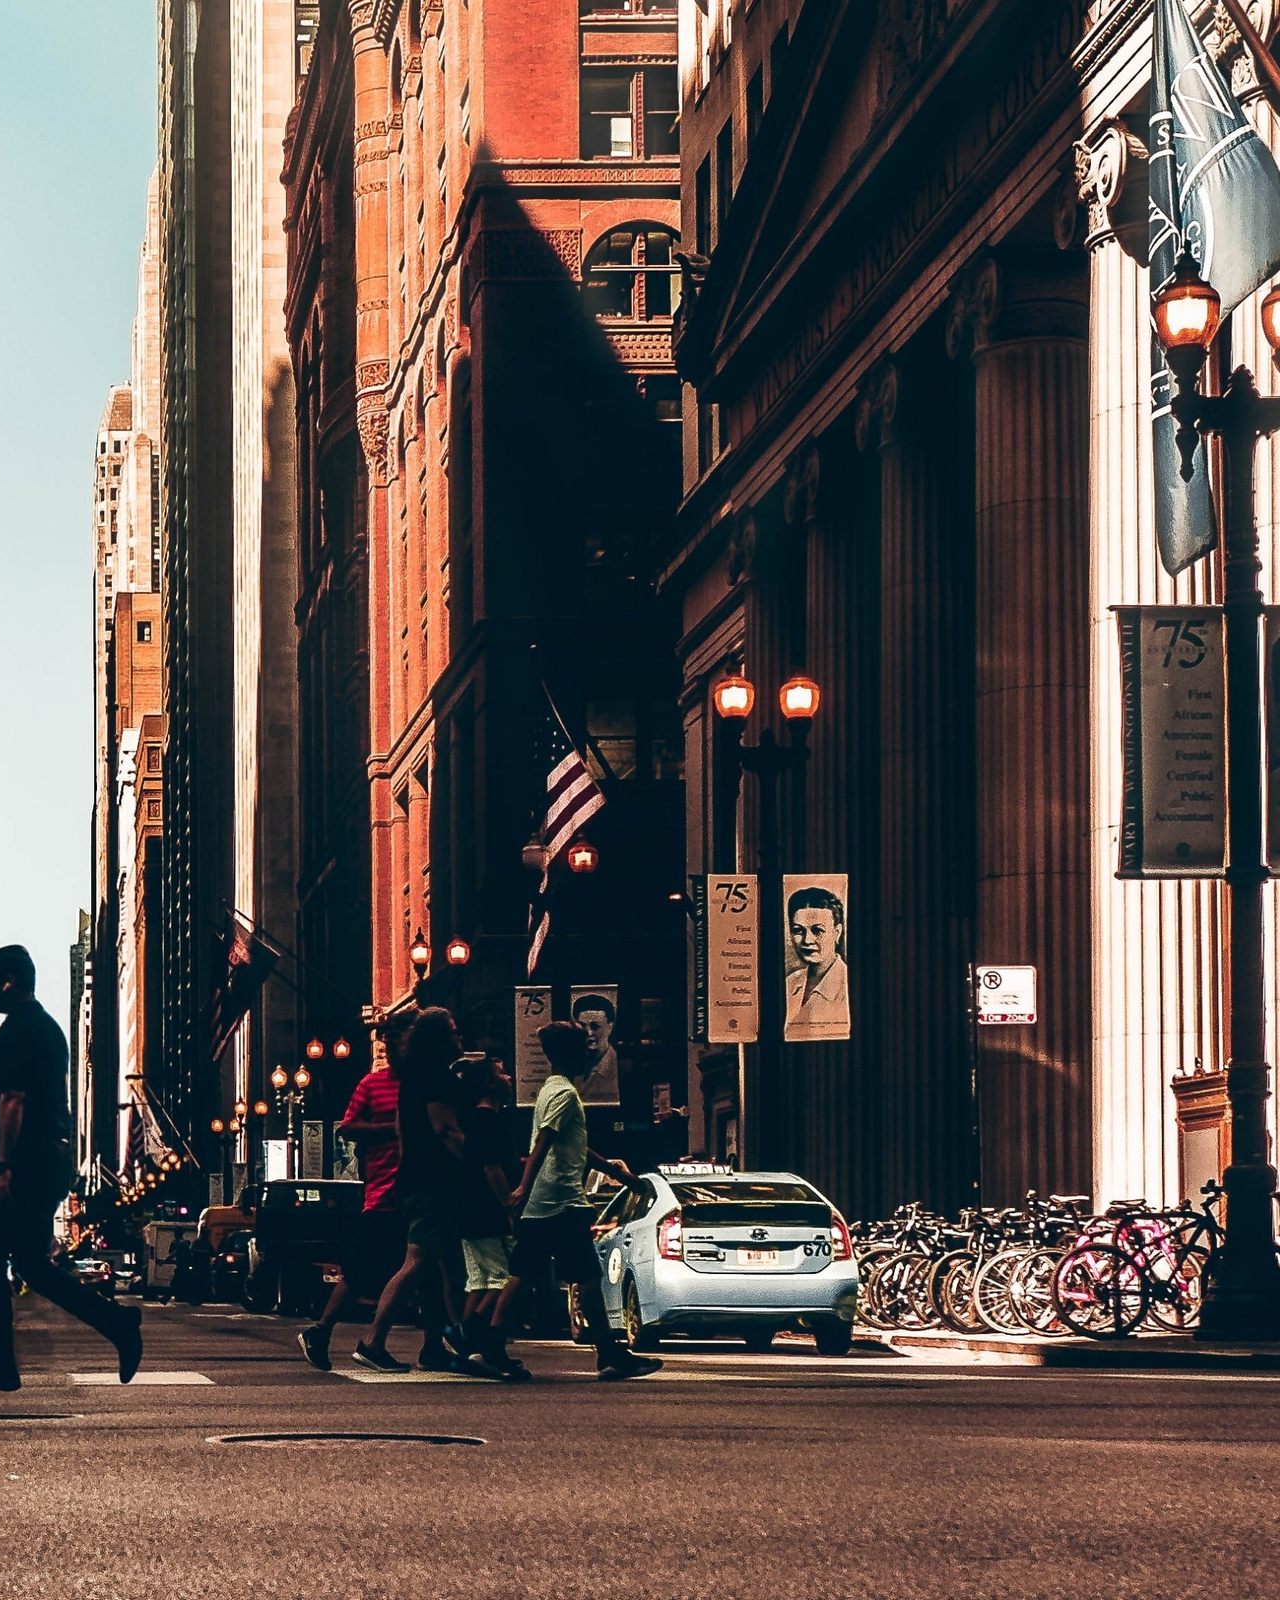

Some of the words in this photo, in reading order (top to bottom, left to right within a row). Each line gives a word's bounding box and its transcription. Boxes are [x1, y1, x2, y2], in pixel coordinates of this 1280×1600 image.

[753, 301, 834, 418] WINTRUST
[851, 148, 966, 307] FINANCIAL
[1122, 622, 1133, 672] WYLIE
[1153, 619, 1206, 669] 75
[1187, 689, 1212, 700] First
[1173, 709, 1213, 720] African
[1123, 681, 1135, 793] WASHINGTON
[1162, 730, 1213, 741] American
[1174, 750, 1213, 761] Female
[1166, 770, 1214, 781] Certified
[1180, 790, 1214, 801] Public
[1153, 811, 1214, 822] Accountant
[1124, 821, 1136, 866] MARY
[715, 883, 748, 913] 75
[696, 921, 705, 988] WASHINGTON
[521, 992, 545, 1016] 75
[696, 1006, 705, 1034] MARY
[803, 1241, 832, 1257] 670
